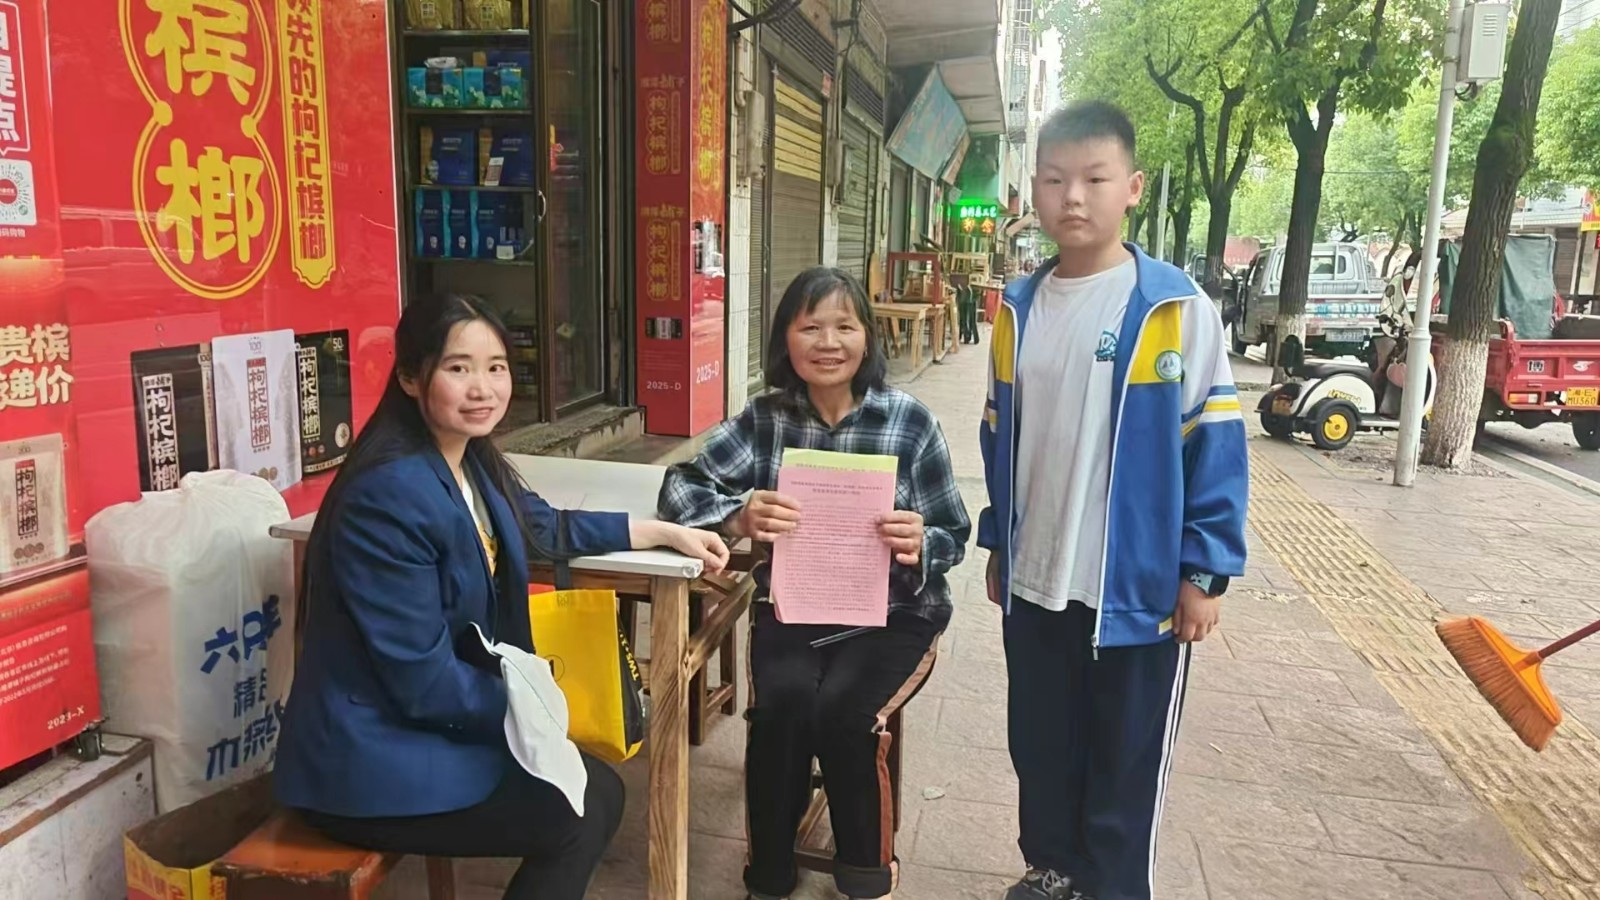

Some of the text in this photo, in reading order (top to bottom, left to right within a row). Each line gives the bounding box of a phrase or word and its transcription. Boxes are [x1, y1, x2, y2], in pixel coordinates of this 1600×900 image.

[146, 0, 264, 263] 槟榔
[249, 366, 269, 444] 枸杞槟榔
[301, 358, 319, 436] 枸杞槟榔
[646, 380, 682, 391] 2025-D
[695, 360, 720, 384] 2025-D
[146, 387, 178, 491] 枸杞槟榔
[48, 705, 85, 730] 2023-X
